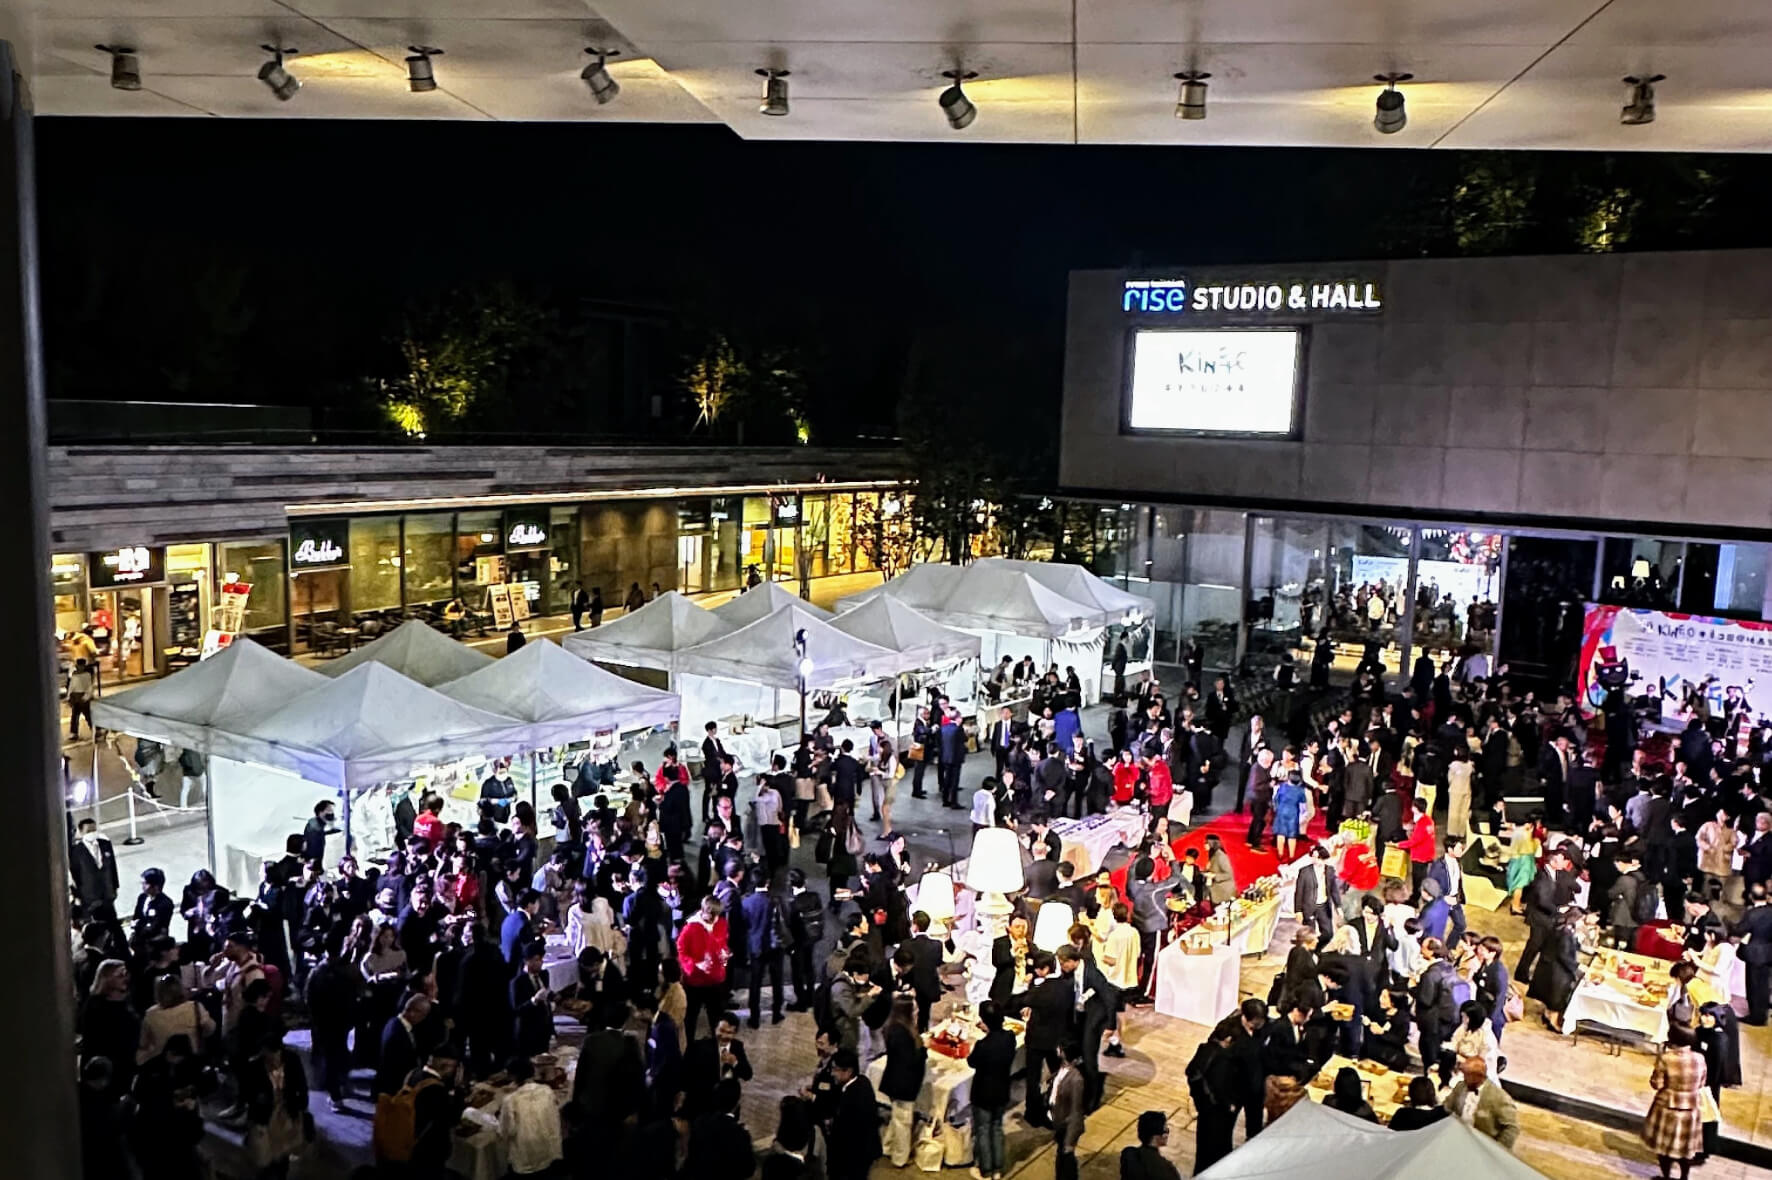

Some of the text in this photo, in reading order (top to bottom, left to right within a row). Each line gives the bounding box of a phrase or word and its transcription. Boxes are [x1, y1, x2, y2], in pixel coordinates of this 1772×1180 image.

[1124, 283, 1382, 311] rise STUDIO & HALL
